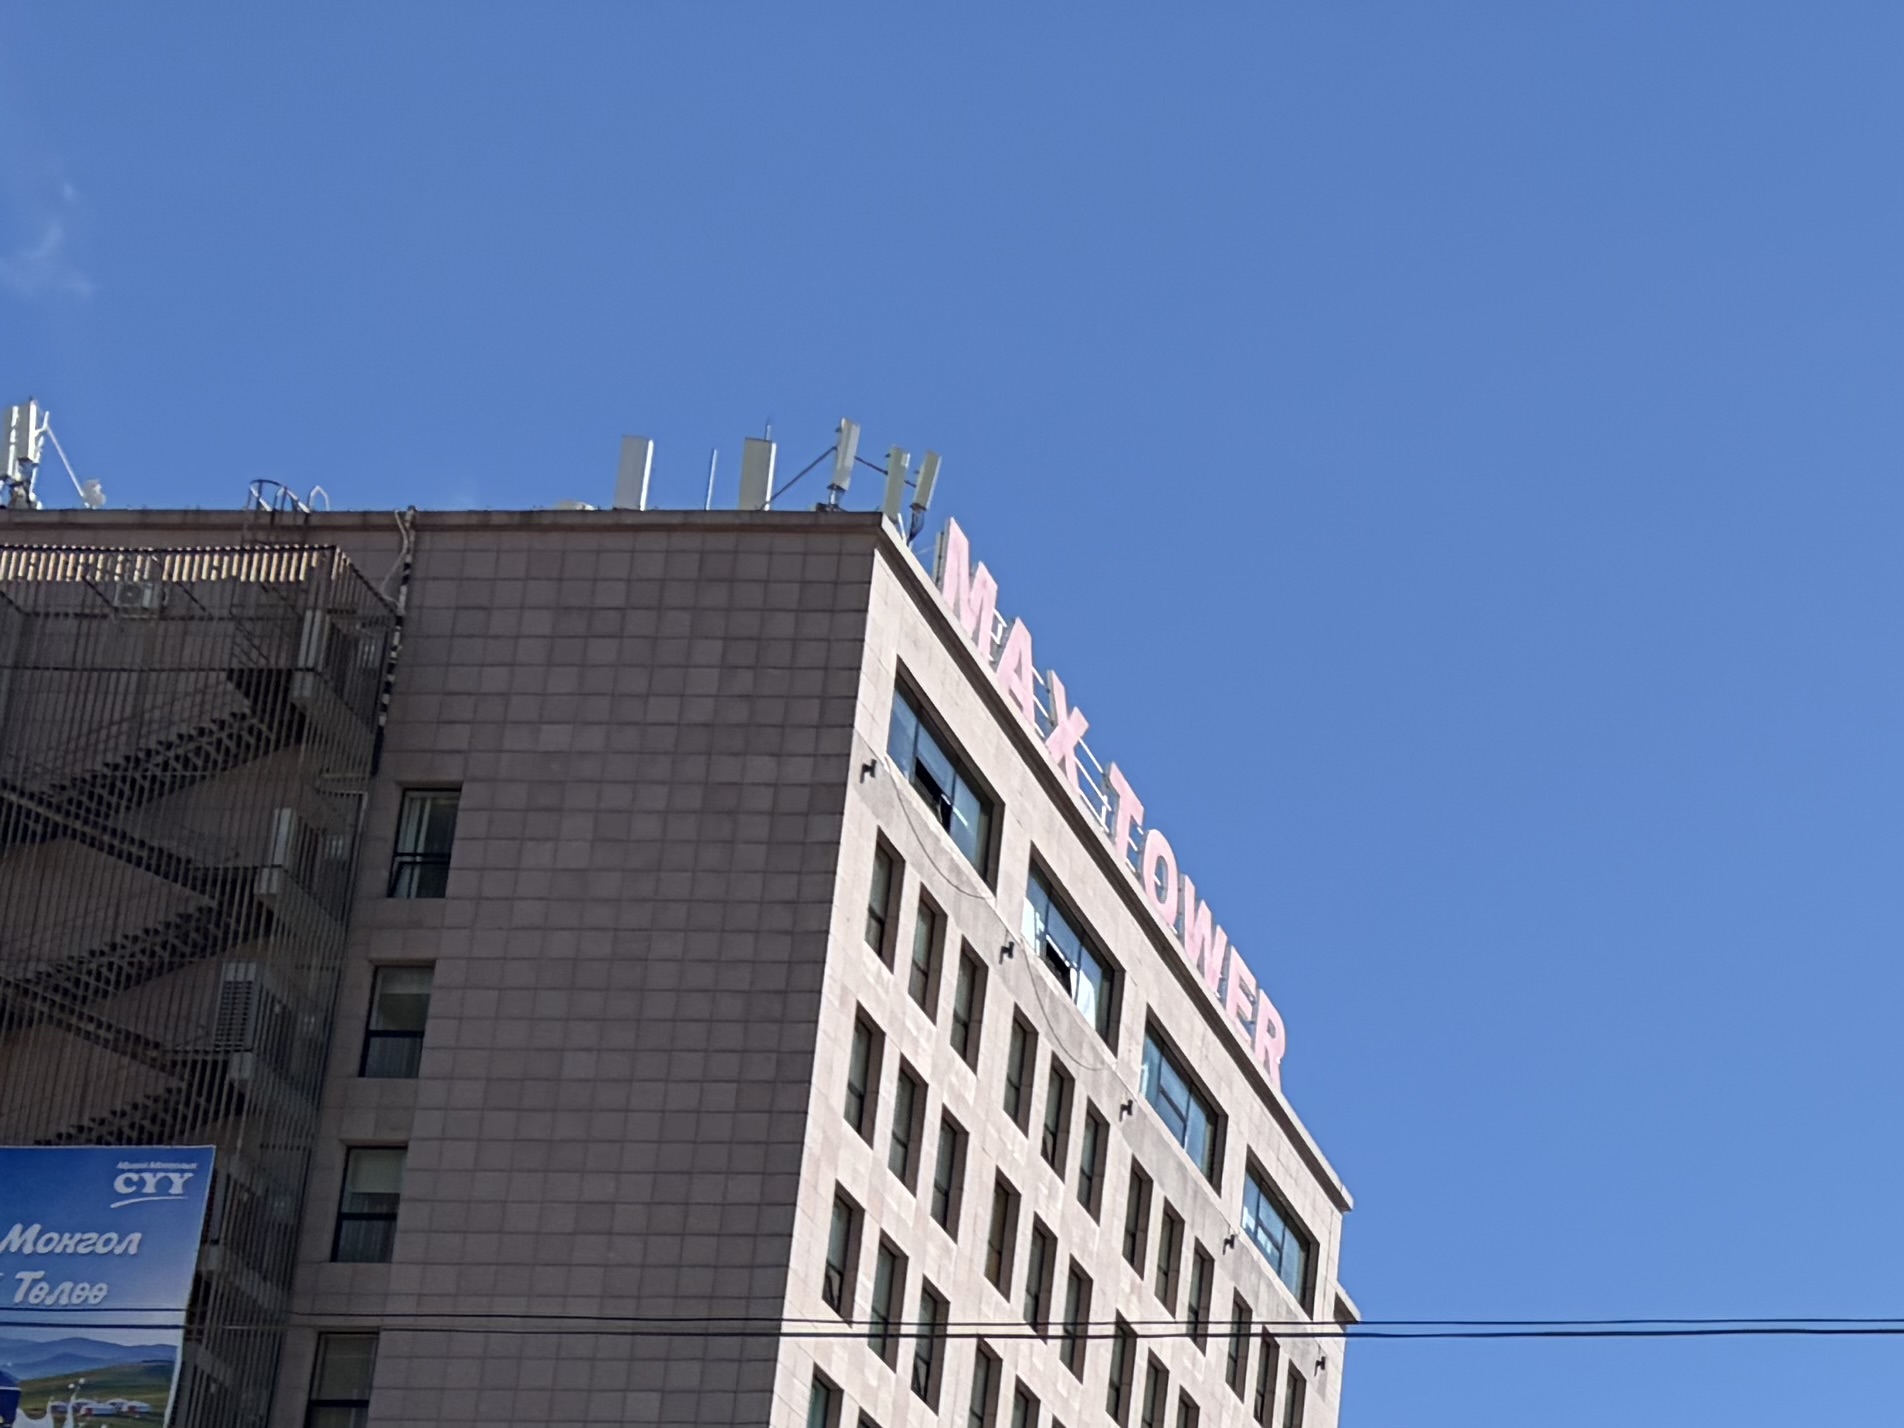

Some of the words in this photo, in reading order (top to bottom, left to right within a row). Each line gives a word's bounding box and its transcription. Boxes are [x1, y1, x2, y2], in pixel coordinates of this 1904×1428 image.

[940, 516, 1089, 796] MAX
[1108, 762, 1287, 1090] TOWER
[1, 1223, 143, 1255] Монгол
[14, 1270, 108, 1305] Төлөө
